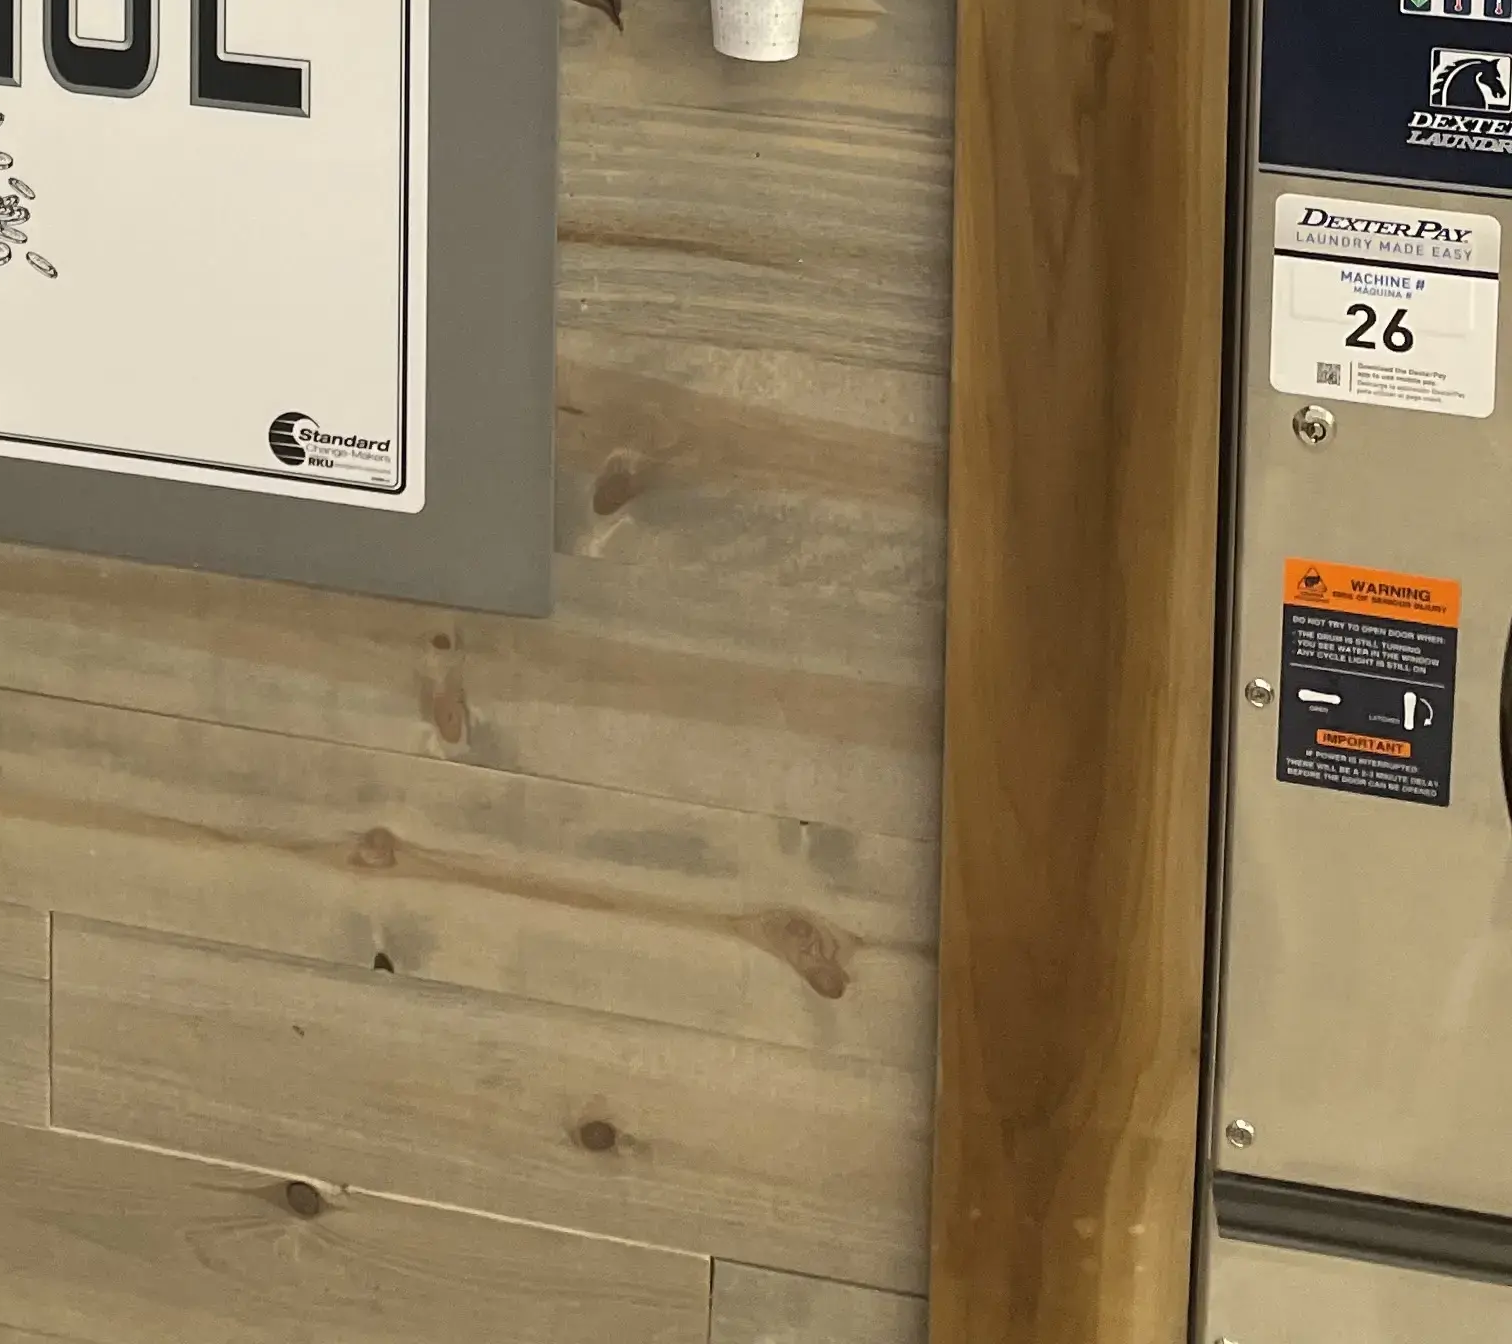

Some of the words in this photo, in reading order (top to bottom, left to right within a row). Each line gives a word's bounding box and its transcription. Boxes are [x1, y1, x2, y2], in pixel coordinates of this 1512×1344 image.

[1408, 111, 1512, 136] DEXTE
[1407, 130, 1512, 154] LAUNDR
[1296, 231, 1373, 251] LAUNDRY
[1380, 238, 1425, 256] MADE
[1432, 246, 1473, 262] EASY
[1341, 270, 1411, 289] MACHINE
[1345, 303, 1414, 353] 26
[298, 428, 391, 453] Standard
[1351, 579, 1431, 602] WARNING
[1292, 615, 1306, 624] DO
[1307, 617, 1326, 627] NOT
[1328, 619, 1345, 629] TRY
[1347, 622, 1360, 632] TO
[1361, 624, 1387, 636] OPEN
[1388, 629, 1415, 640] DOOR
[1297, 630, 1315, 639] THE
[1316, 632, 1343, 643] DRUM
[1355, 638, 1378, 649] STILL
[1381, 642, 1422, 655] TURNING
[1297, 639, 1316, 649] YOU
[1318, 642, 1335, 651] SEE
[1337, 644, 1369, 656] WATER
[1382, 650, 1399, 661] THE
[1401, 654, 1440, 666] WINDOW
[1297, 648, 1315, 657] ANY
[1316, 651, 1346, 662] CYCLE
[1347, 655, 1374, 666] LIGHT
[1387, 661, 1411, 672] STILL
[1412, 665, 1427, 674] ON
[1322, 732, 1404, 754] IMPORTANT
[1315, 751, 1347, 762] POWER
[1287, 767, 1321, 780] BEFORE
[1323, 773, 1339, 782] THE
[1341, 774, 1366, 786] DOOR
[1401, 785, 1437, 797] OPENED
[1339, 766, 1351, 775] BE
[1410, 776, 1438, 788] DELAY
